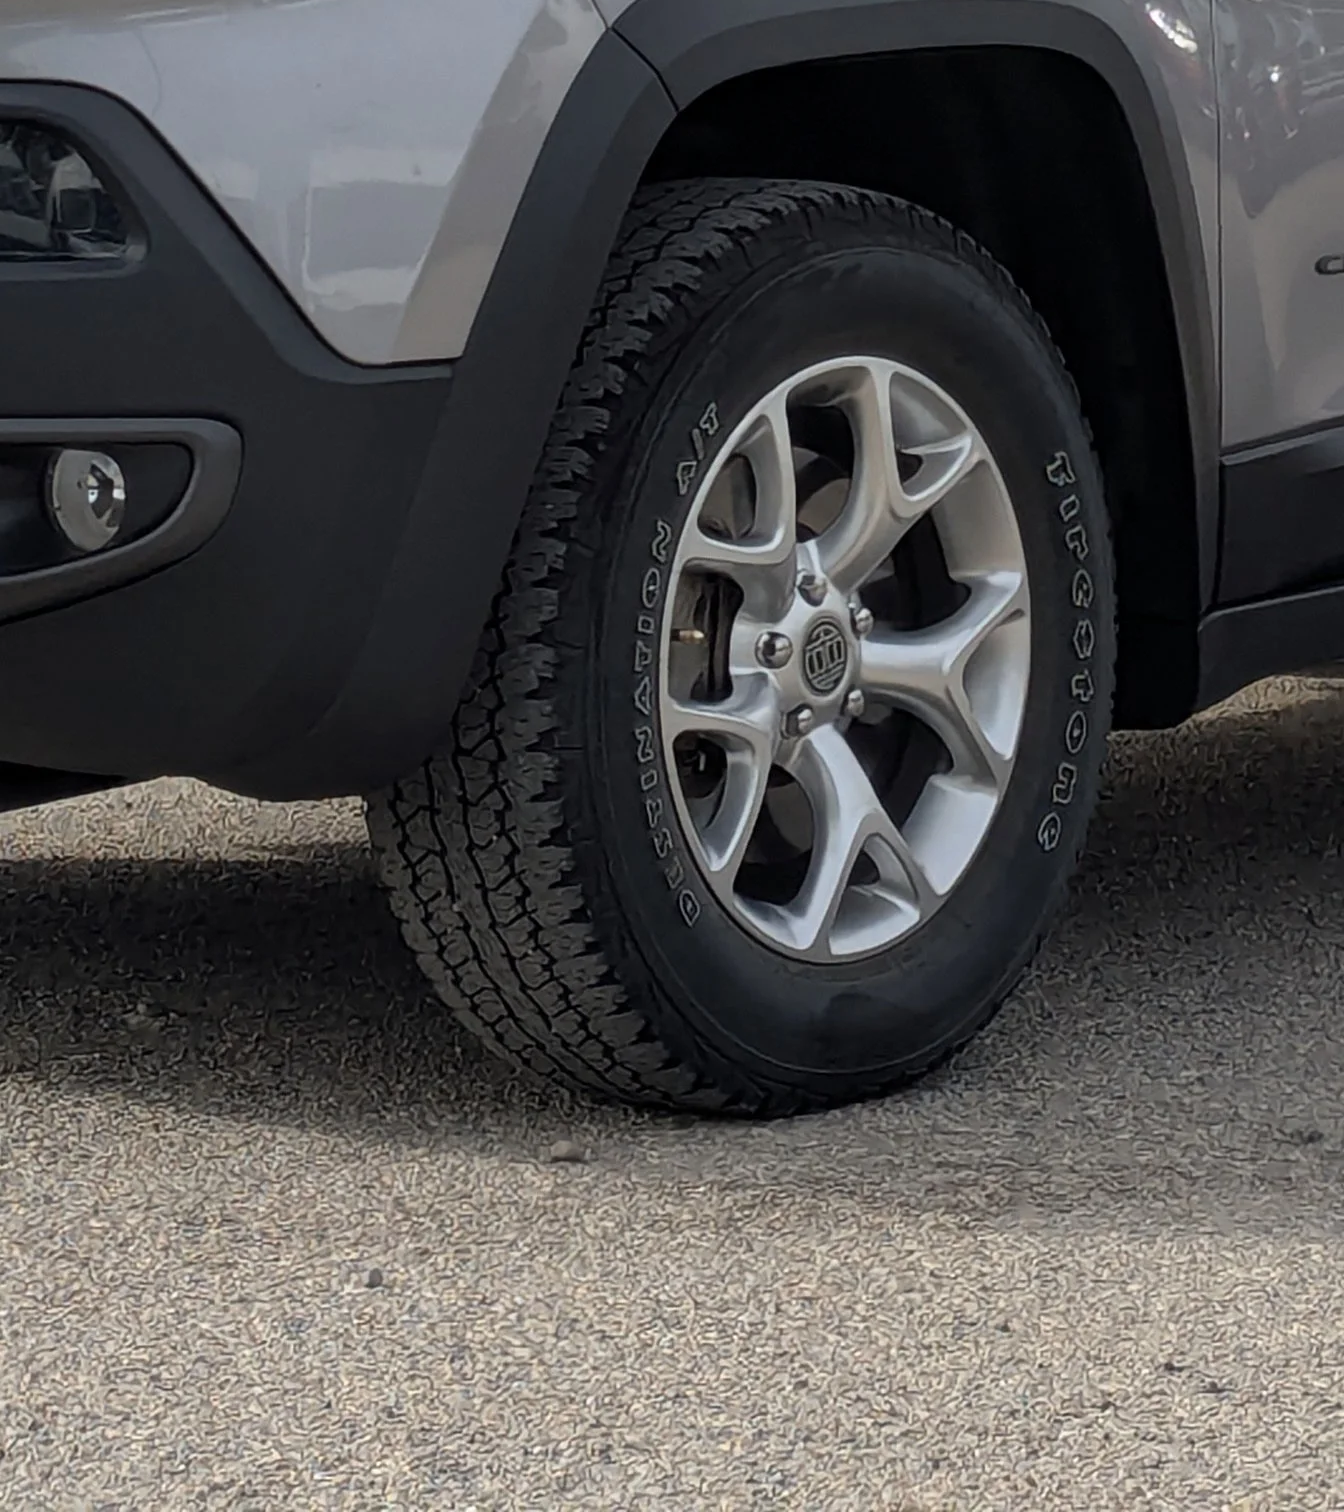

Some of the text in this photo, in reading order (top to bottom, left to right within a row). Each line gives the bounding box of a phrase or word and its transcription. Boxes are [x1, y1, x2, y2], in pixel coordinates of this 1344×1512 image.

[633, 400, 721, 928] DESTINATION A/T
[1036, 450, 1096, 852] Firestone
